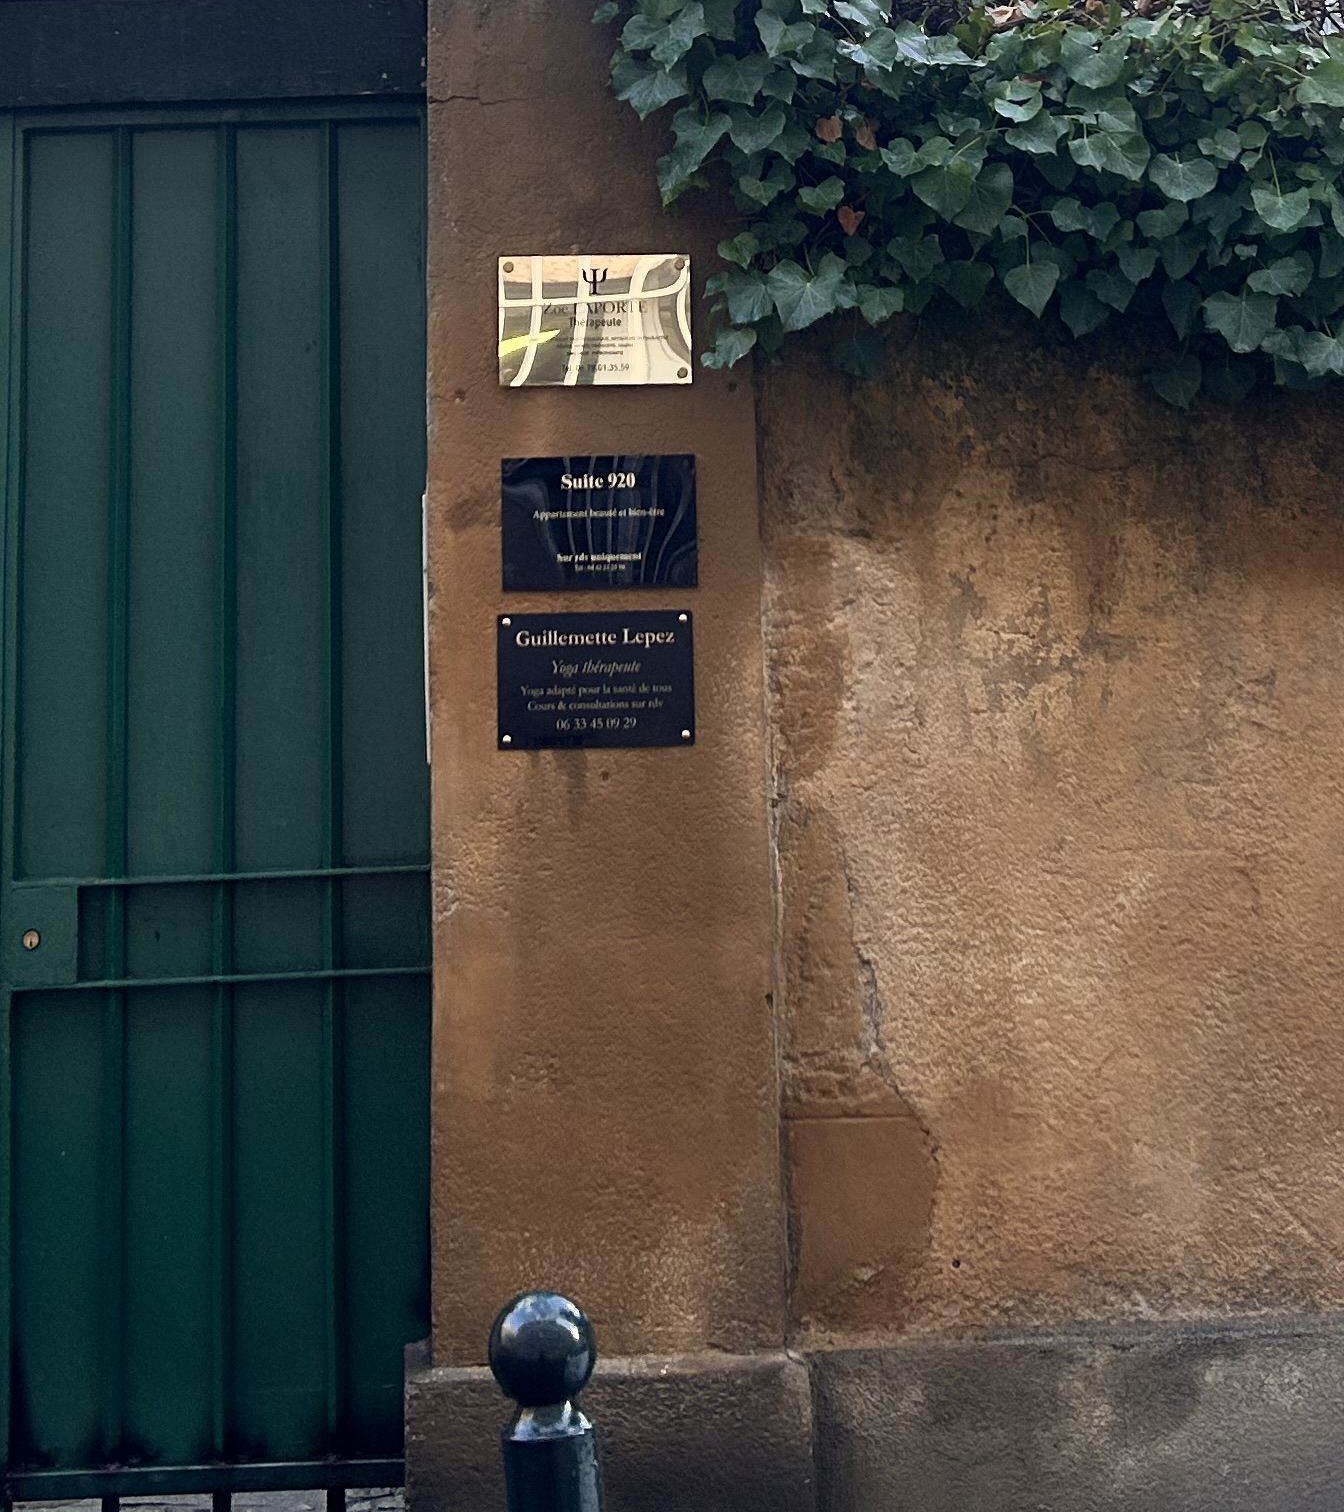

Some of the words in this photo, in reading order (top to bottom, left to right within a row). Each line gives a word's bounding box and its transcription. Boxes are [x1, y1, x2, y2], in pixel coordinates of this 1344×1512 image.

[560, 473, 604, 490] Suite
[608, 472, 636, 488] 920
[533, 509, 588, 521] Appartement
[618, 509, 627, 517] et
[515, 630, 617, 647] Guillemette
[622, 628, 675, 648] Lepez
[552, 660, 579, 677] Yoga
[582, 659, 641, 677] thérapeute
[520, 685, 544, 698] Yoga
[546, 685, 576, 697] adapté
[578, 686, 600, 697] pour
[603, 684, 611, 694] la
[612, 683, 636, 694] santé
[639, 683, 650, 693] de
[652, 684, 672, 693] tous
[527, 700, 555, 711] Cours
[557, 700, 566, 710] &
[568, 699, 629, 709] consultations
[648, 697, 663, 708] rdv
[556, 719, 570, 730] 06
[574, 719, 587, 730] 33
[590, 718, 603, 729] 45
[606, 717, 620, 729] 09
[623, 717, 637, 728] 29
